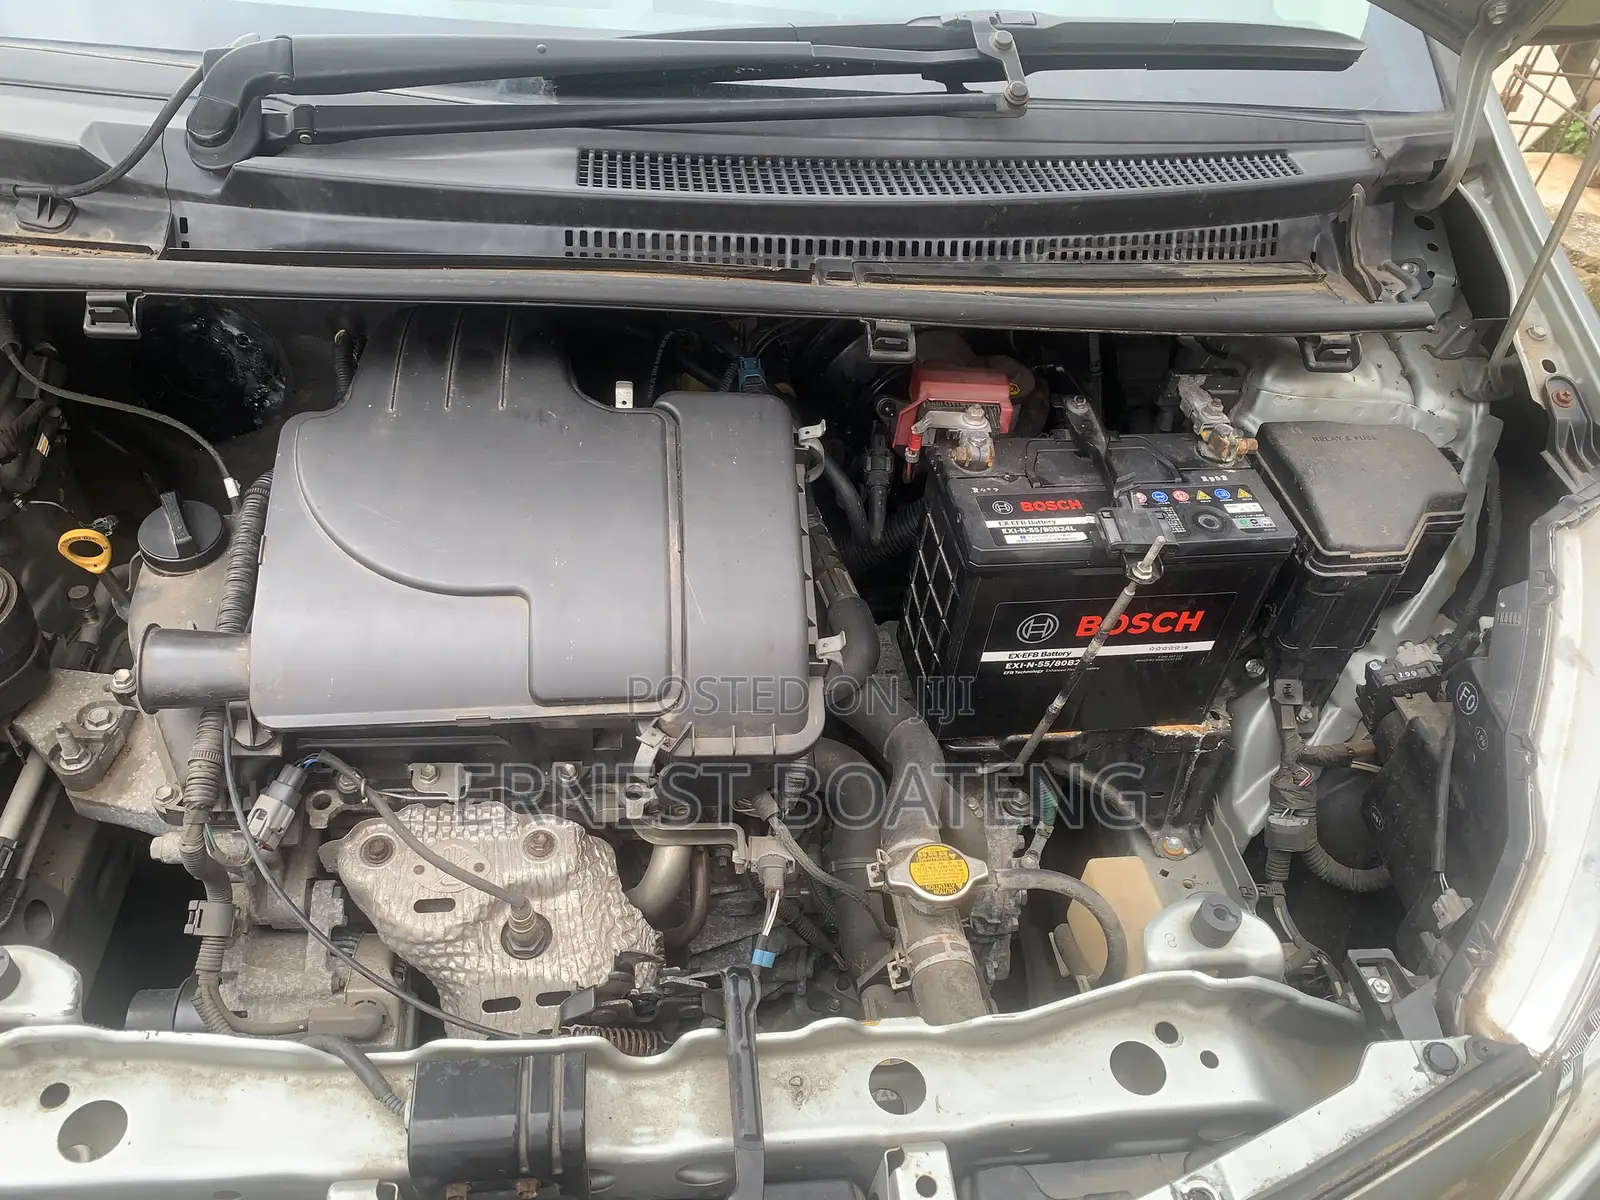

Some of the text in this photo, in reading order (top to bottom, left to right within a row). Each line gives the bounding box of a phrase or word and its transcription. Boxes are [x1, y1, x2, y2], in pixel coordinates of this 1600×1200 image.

[1019, 499, 1083, 512] BOSCH
[1028, 518, 1056, 526] Battery
[1040, 650, 1072, 659] Battery
